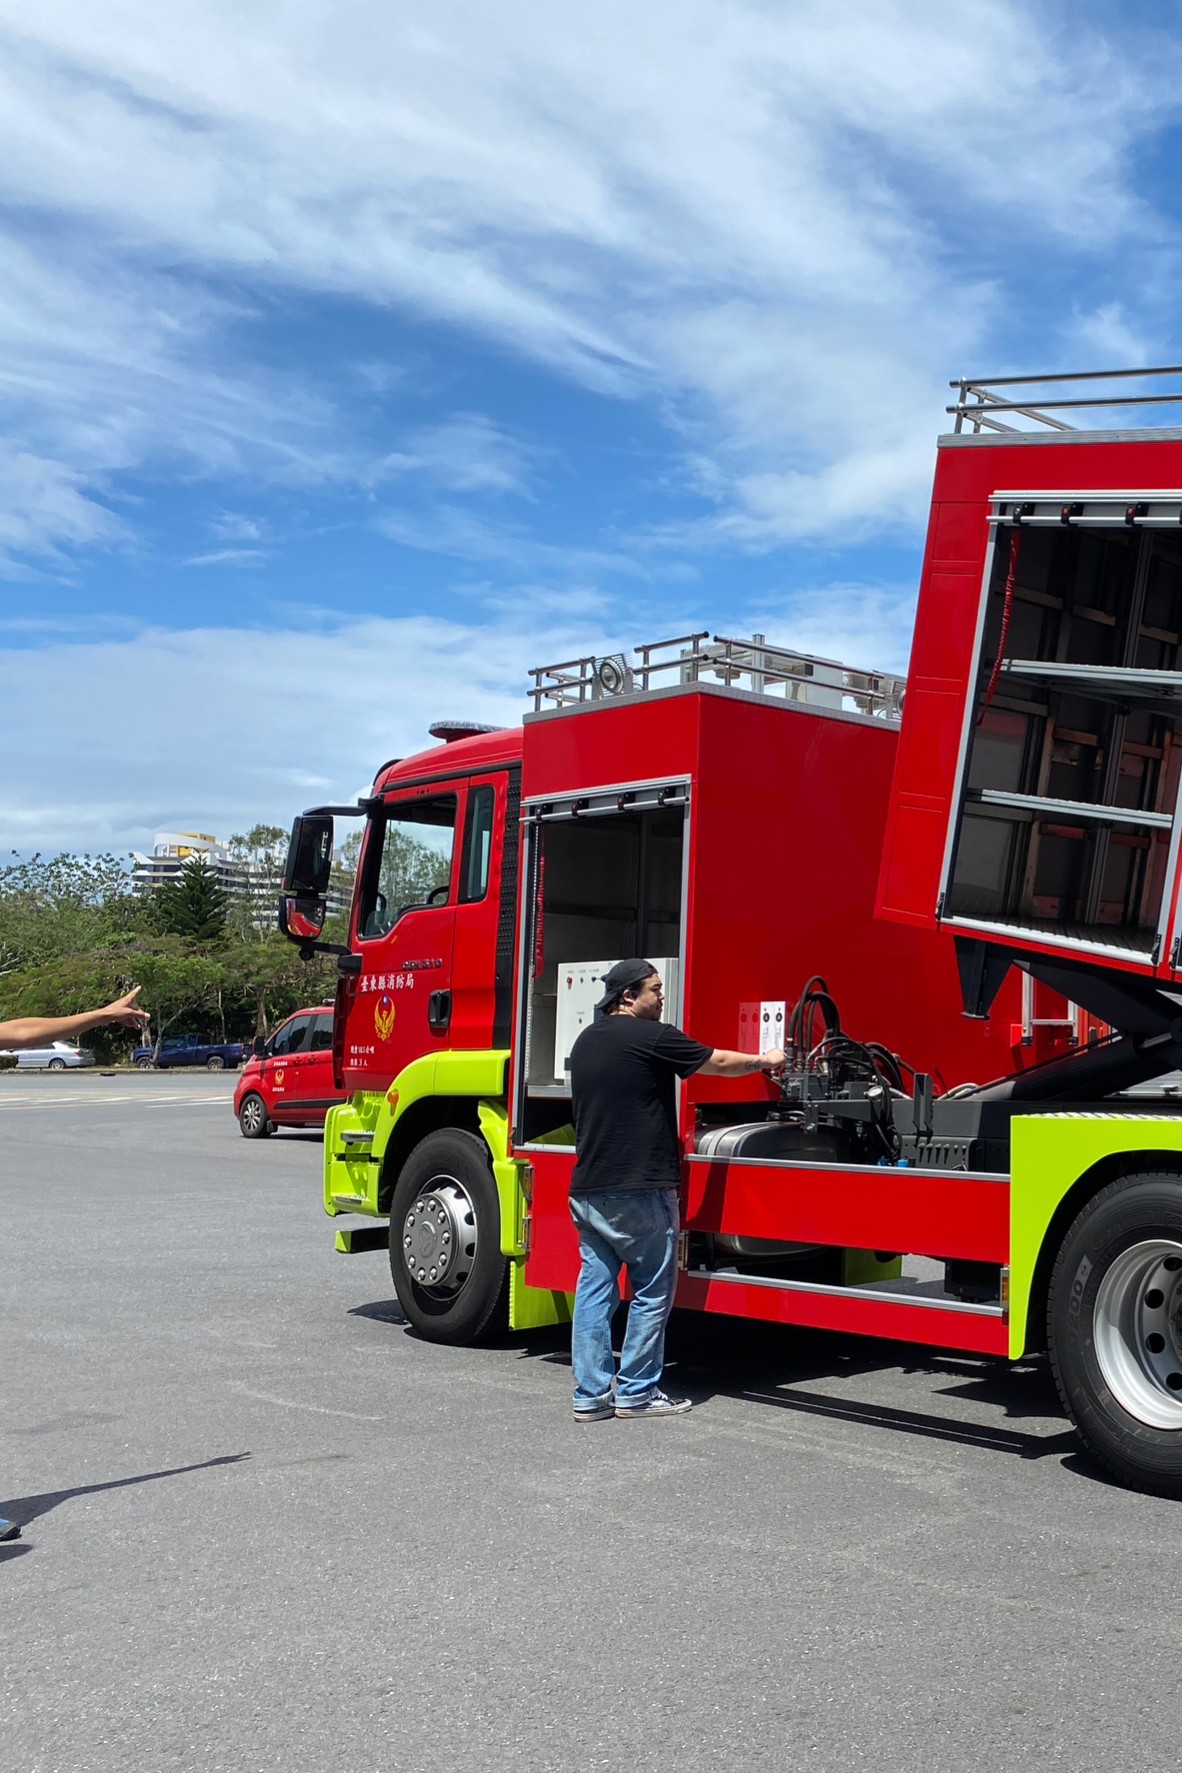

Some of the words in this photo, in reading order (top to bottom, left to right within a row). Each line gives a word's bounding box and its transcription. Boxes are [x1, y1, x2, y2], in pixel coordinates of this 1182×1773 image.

[360, 973, 415, 992] 臺東縣消防局
